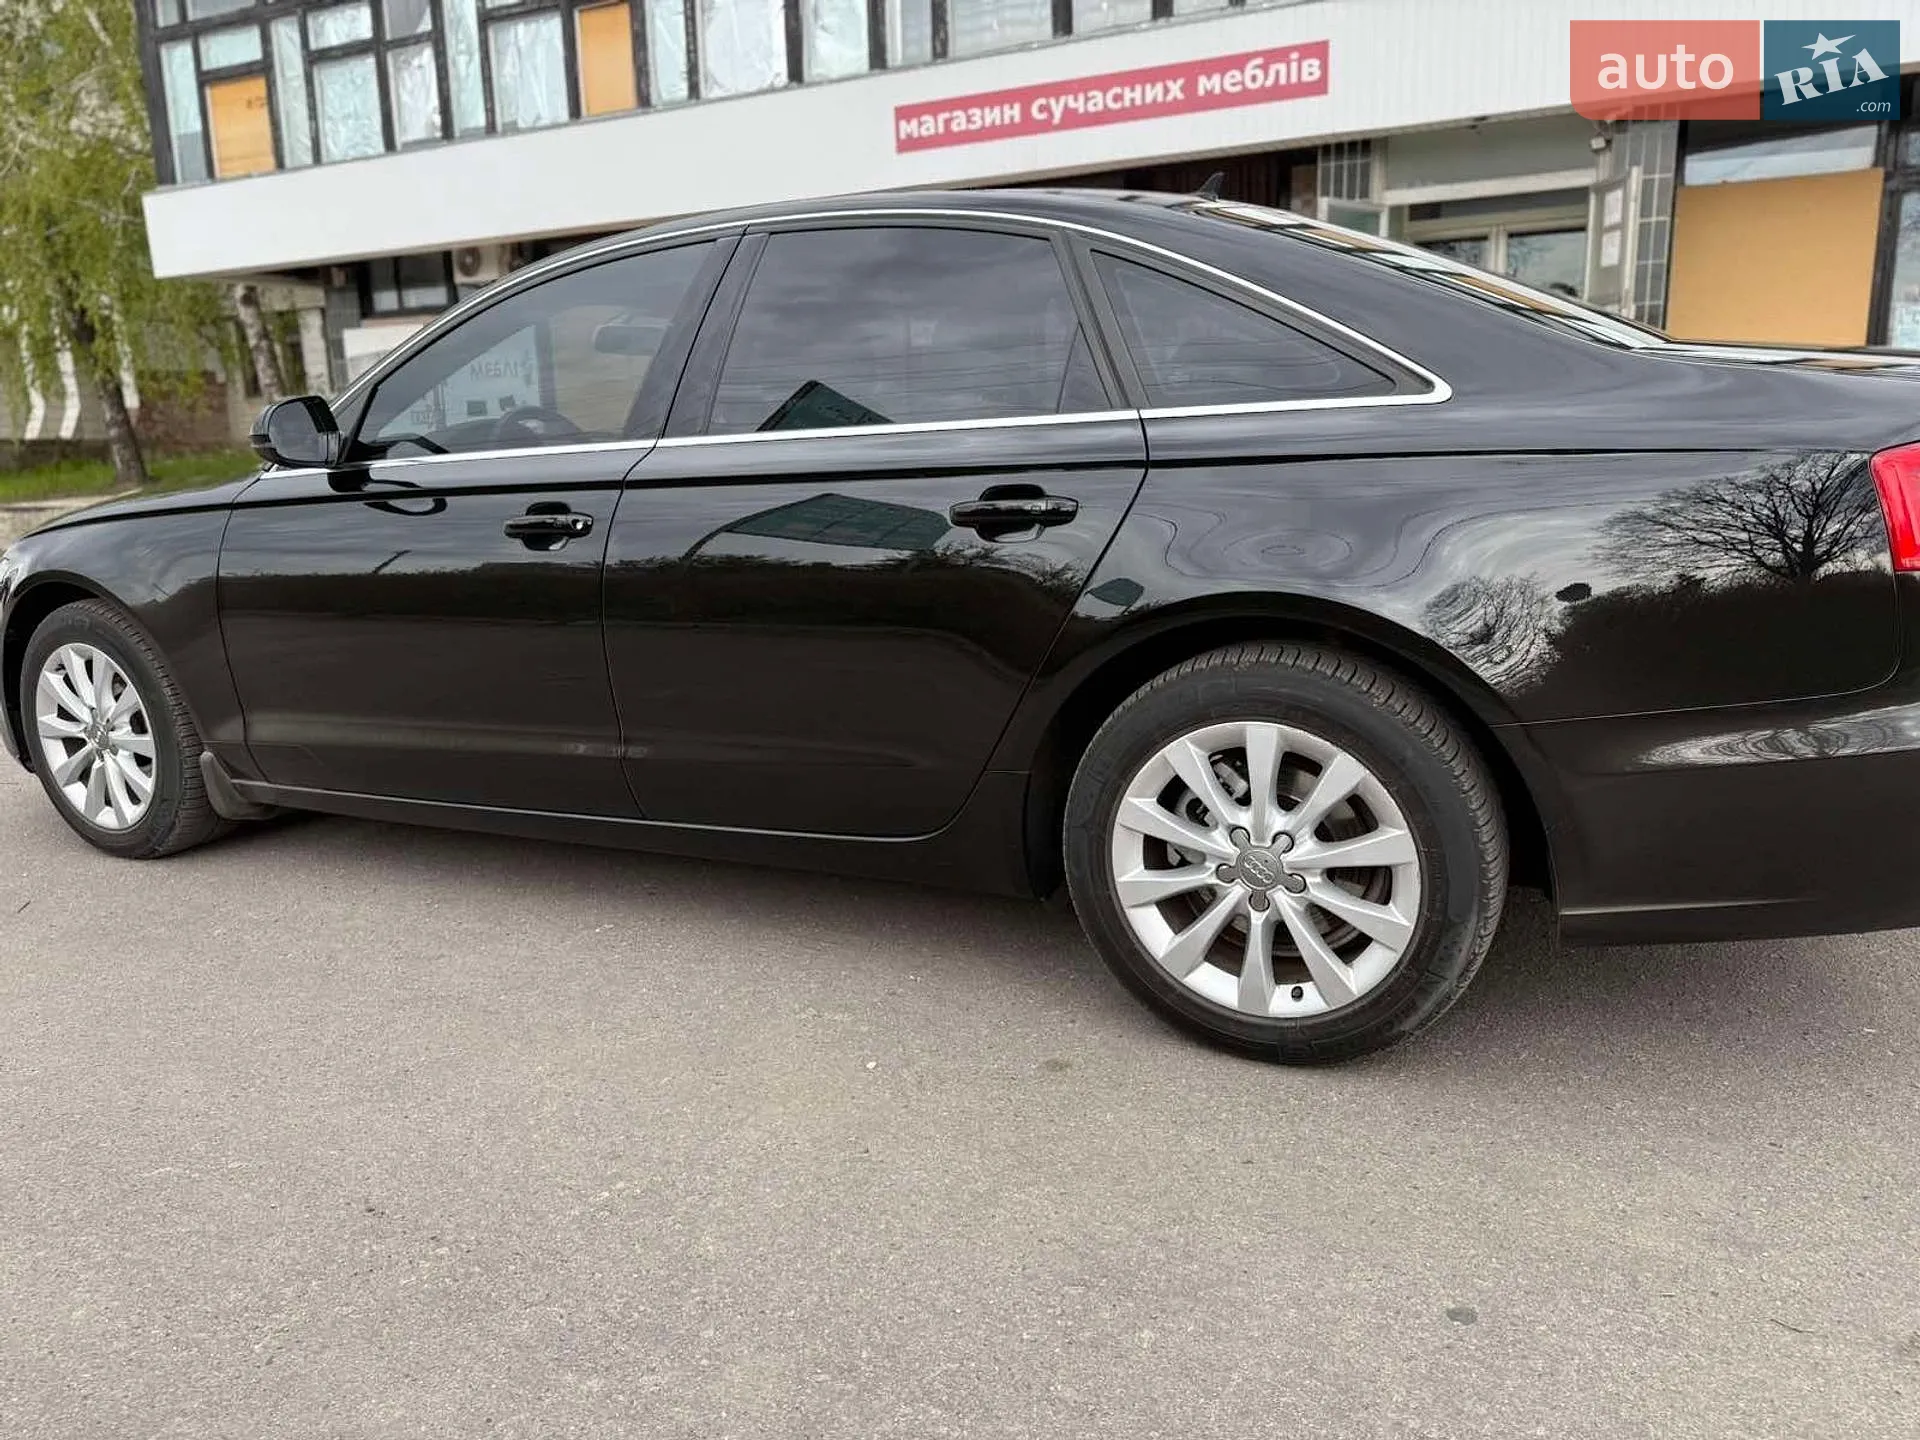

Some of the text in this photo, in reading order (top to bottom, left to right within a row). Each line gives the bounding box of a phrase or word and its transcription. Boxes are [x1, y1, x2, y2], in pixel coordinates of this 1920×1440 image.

[898, 52, 1322, 141] магазин сучасних меблів
